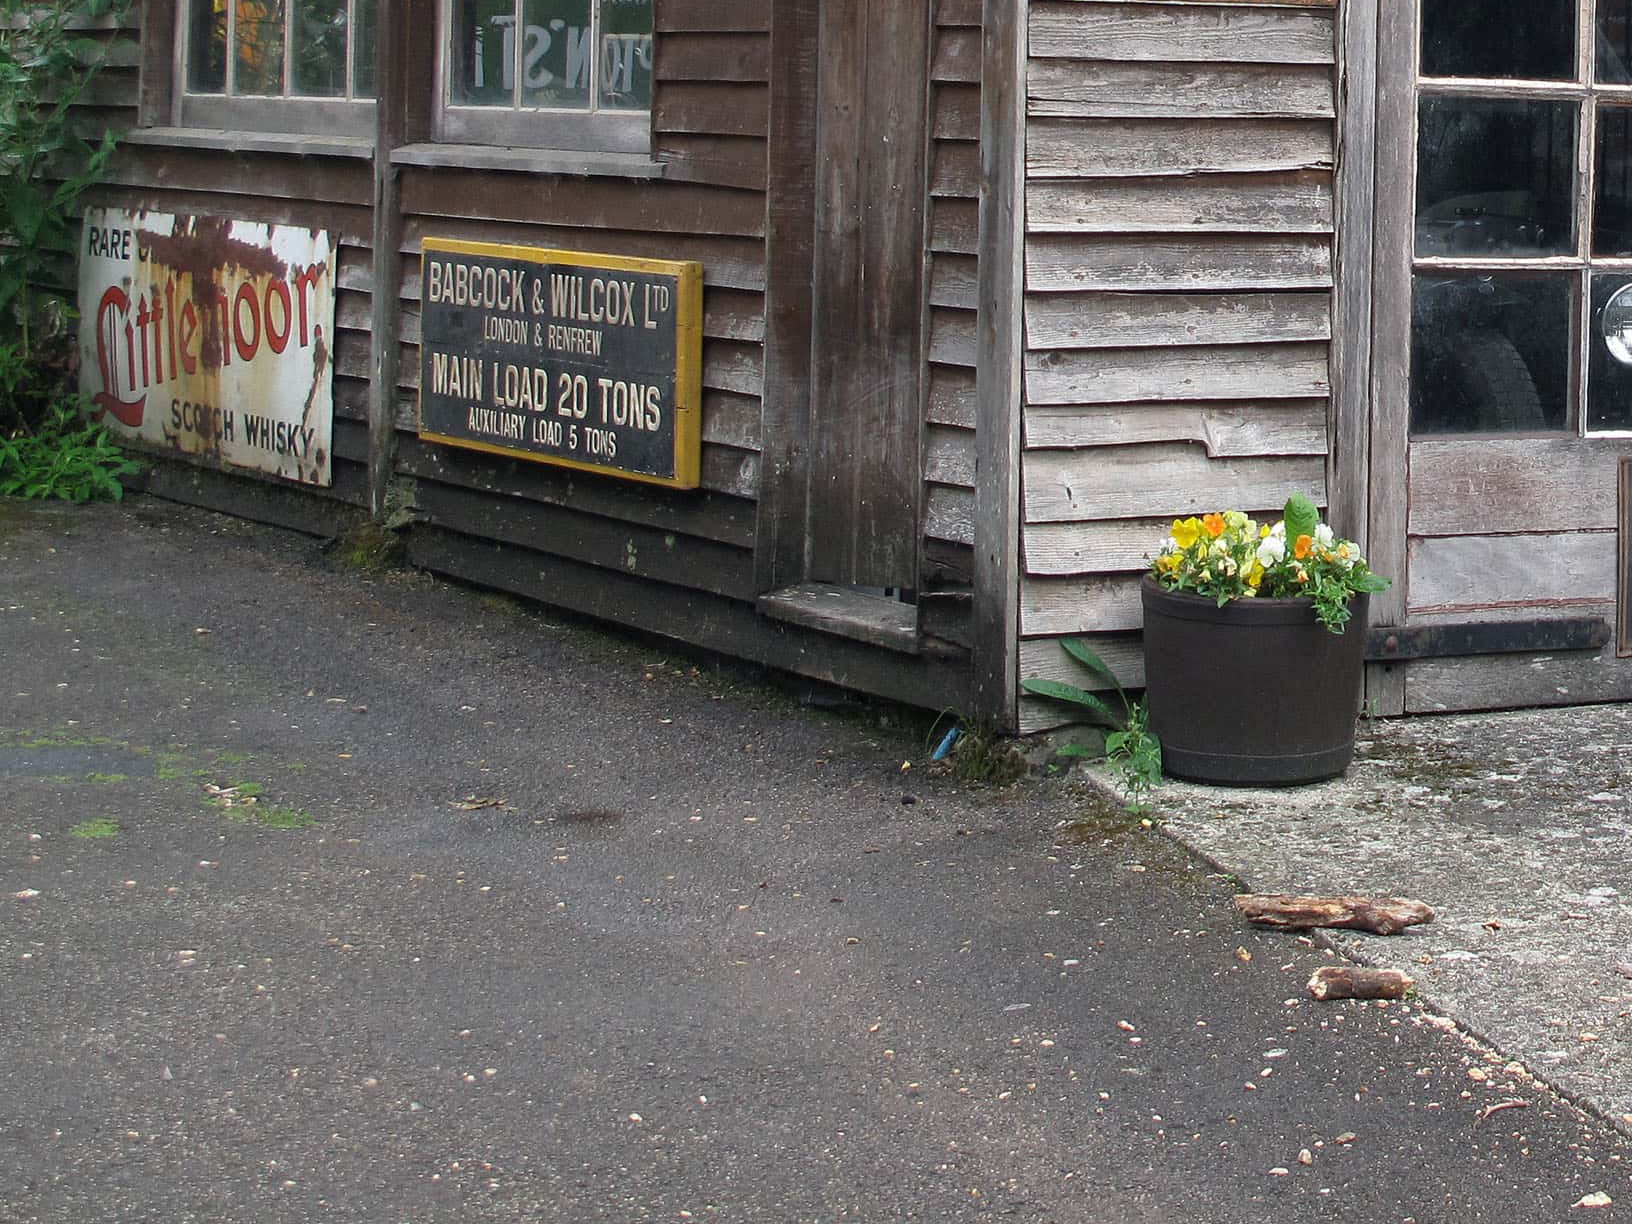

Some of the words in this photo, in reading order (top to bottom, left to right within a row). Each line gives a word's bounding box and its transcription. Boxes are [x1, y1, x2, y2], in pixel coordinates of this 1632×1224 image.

[89, 226, 131, 261] RARE
[429, 261, 526, 313] BABCOCK
[532, 278, 545, 315] &
[551, 274, 635, 326] WILCOX
[485, 316, 528, 345] LONDON
[535, 326, 543, 347] &
[549, 325, 602, 356] RENFREW
[432, 352, 483, 401] MAIN
[493, 362, 548, 413] LOAD
[558, 373, 588, 419] 20
[598, 377, 662, 432] TONS
[171, 398, 234, 442] SCOCH
[244, 413, 316, 459] WHISKY
[468, 406, 526, 441] AUXILIARY
[533, 419, 562, 447] LOAD
[569, 425, 578, 449] 5
[585, 427, 617, 458] TONS
